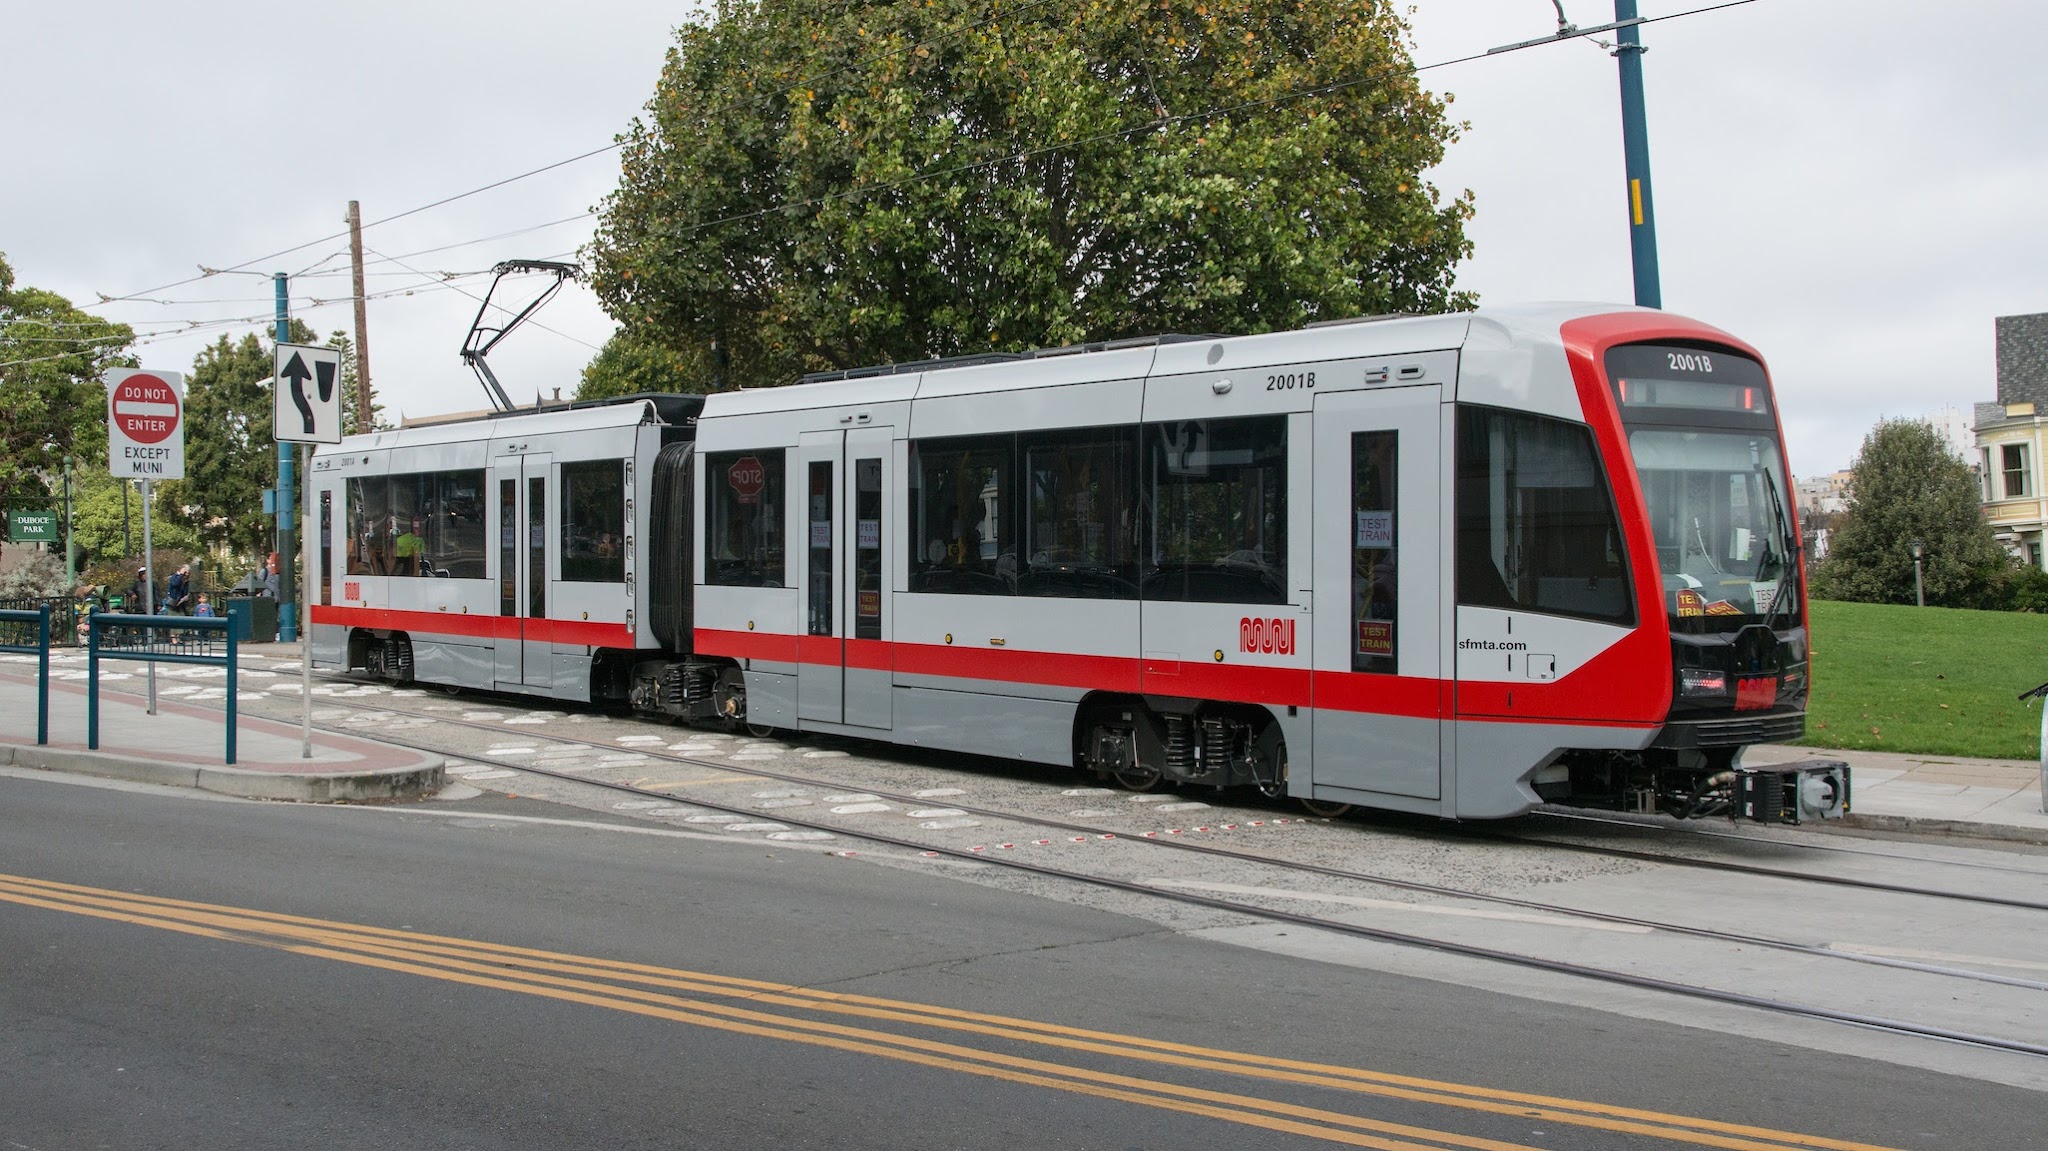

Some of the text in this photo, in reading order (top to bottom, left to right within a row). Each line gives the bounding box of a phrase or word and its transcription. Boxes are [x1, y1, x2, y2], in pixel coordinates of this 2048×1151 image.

[1667, 353, 1713, 373] 2001B
[1266, 372, 1315, 391] 2001B
[125, 387, 167, 400] DO NOT
[127, 419, 166, 431] ENTER
[125, 446, 171, 460] EXCEPT
[133, 461, 162, 474] MUNI
[17, 516, 49, 524] DUBOCE
[1361, 518, 1388, 529] TEST
[23, 525, 44, 533] PARK
[860, 523, 878, 532] TEST
[860, 535, 878, 543] TRAIN
[1360, 530, 1390, 541] TRAIN
[1755, 589, 1776, 601] TEST
[861, 604, 878, 612] TRAIN
[1362, 627, 1387, 637] TEST
[1360, 639, 1391, 649] TRAIN
[1458, 639, 1527, 651] sfmta.com
